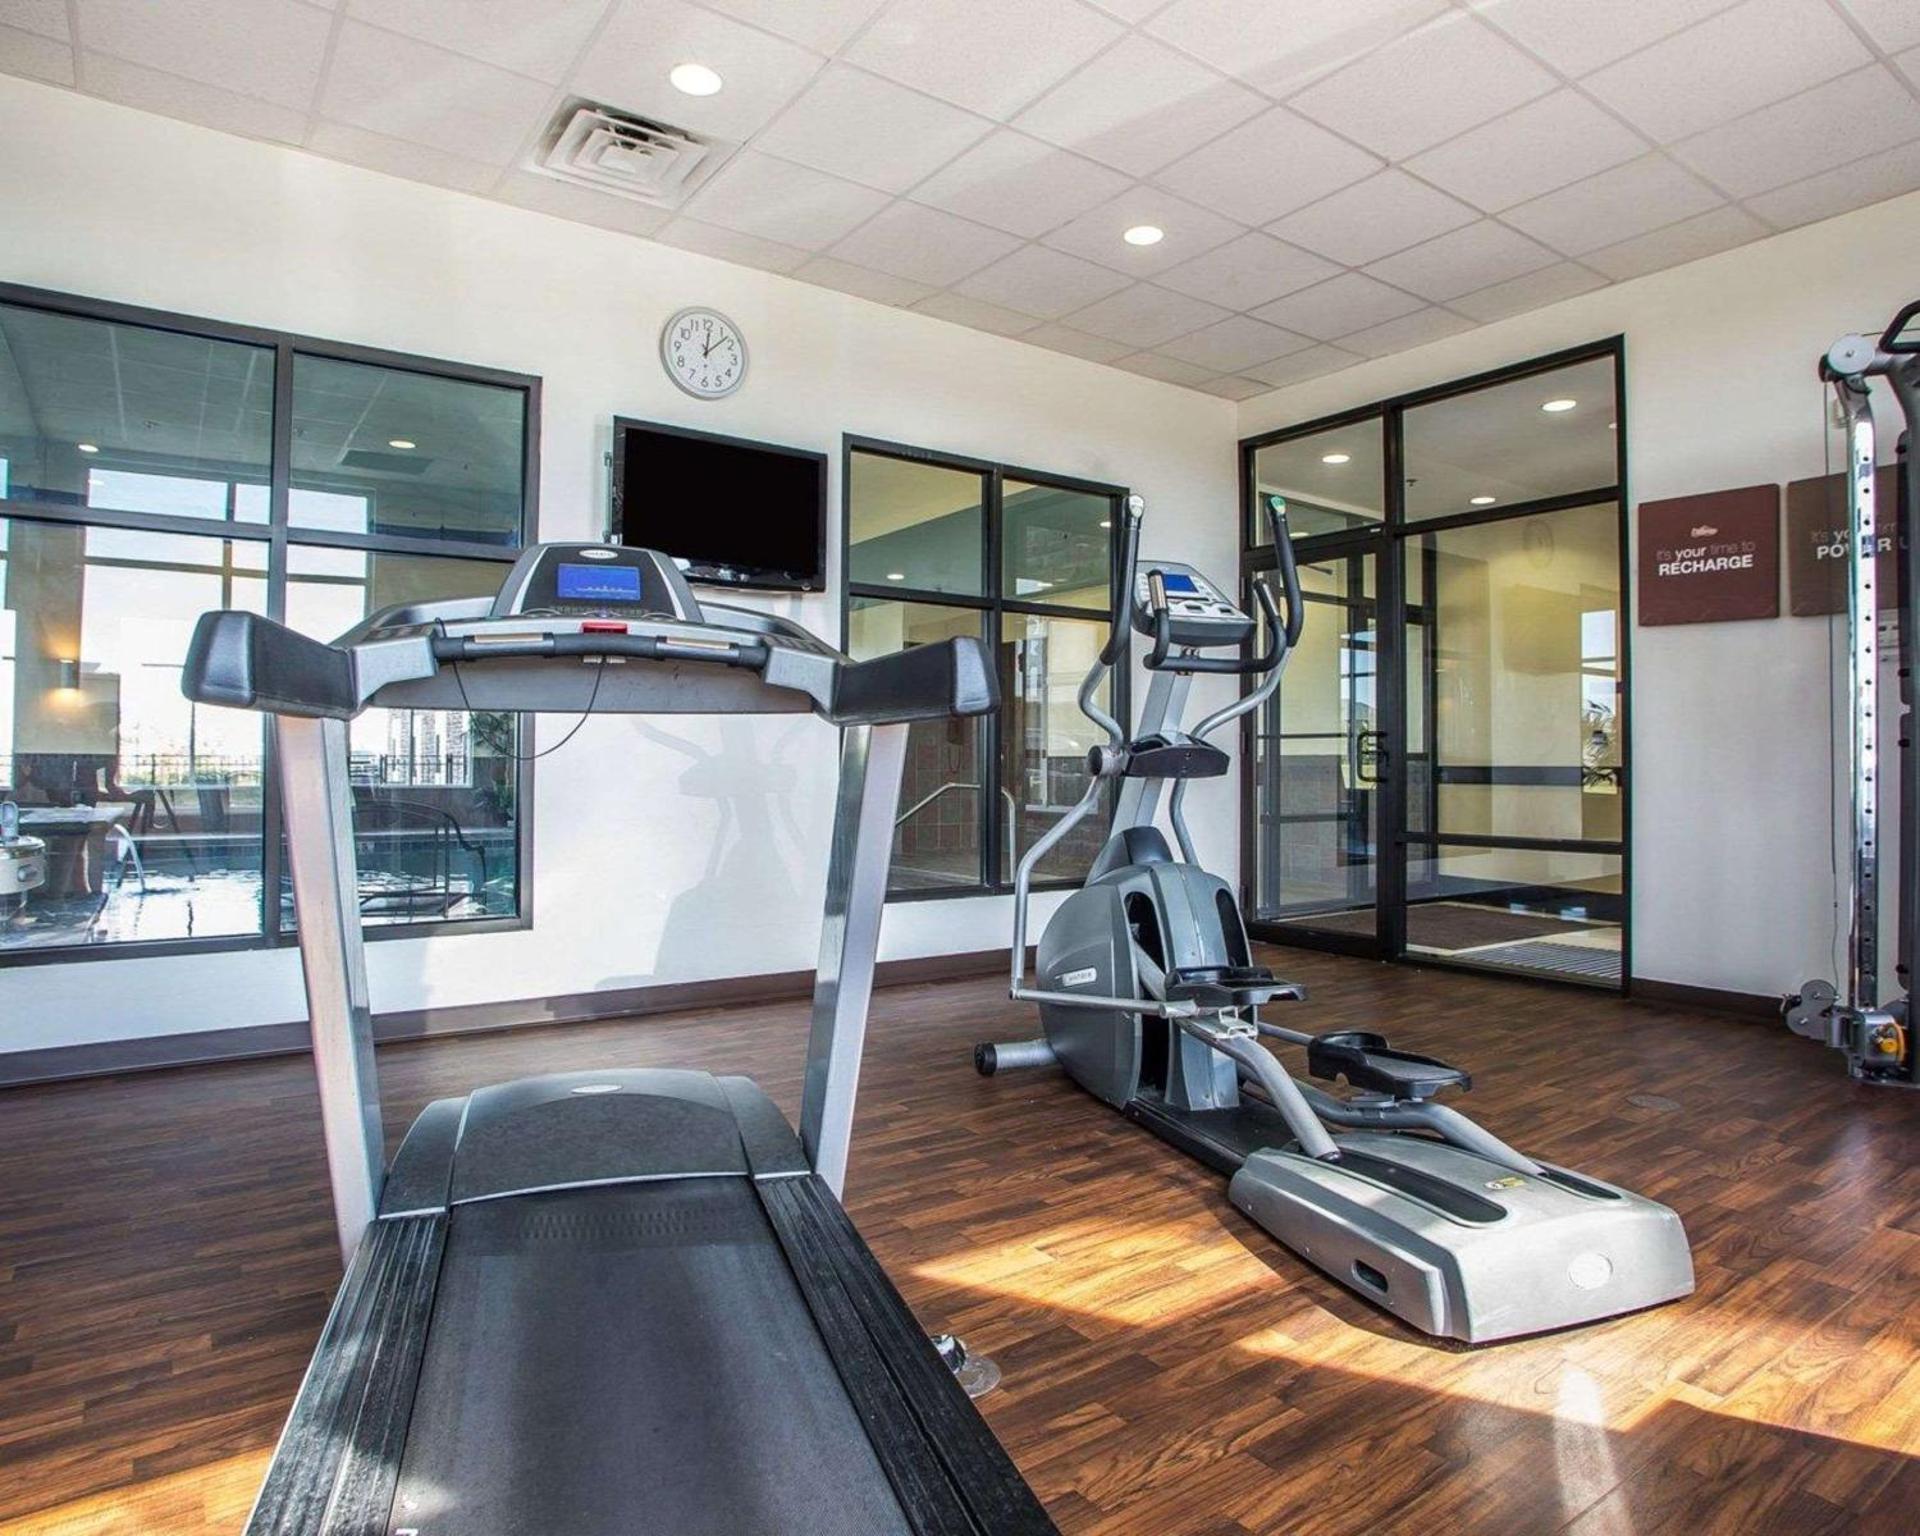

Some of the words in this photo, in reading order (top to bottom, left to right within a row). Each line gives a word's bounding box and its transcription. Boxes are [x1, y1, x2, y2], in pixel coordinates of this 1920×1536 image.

[690, 319, 699, 331] 11
[702, 318, 714, 332] 12
[680, 327, 691, 340] 10
[674, 341, 682, 352] 9
[727, 340, 735, 351] 2
[676, 355, 685, 368] 8
[730, 354, 738, 366] 3
[689, 368, 696, 380] 7
[725, 368, 732, 377] 4
[700, 376, 709, 388] 6
[714, 375, 723, 387] 5
[1675, 546, 1707, 563] your
[1658, 554, 1754, 577] RECHARGE
